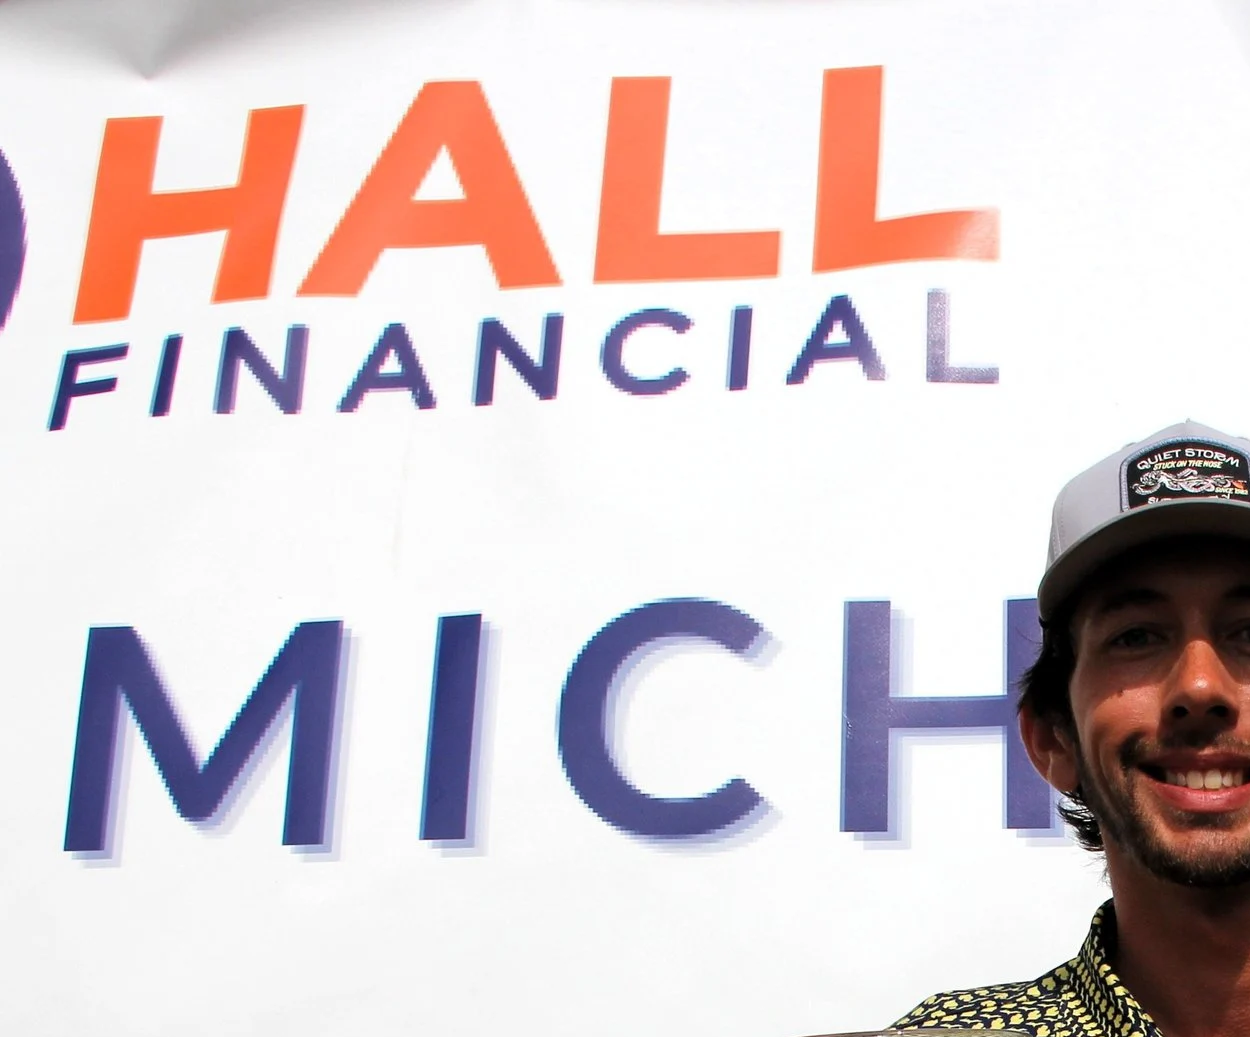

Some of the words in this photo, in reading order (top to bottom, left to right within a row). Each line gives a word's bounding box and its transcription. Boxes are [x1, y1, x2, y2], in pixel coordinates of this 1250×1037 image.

[71, 64, 1000, 326] HALL
[46, 288, 1000, 432] FINANCIAL
[1137, 449, 1181, 470] QUIET
[1185, 448, 1239, 468] STORM
[1153, 461, 1176, 471] STUCK
[1176, 460, 1187, 468] ON
[1188, 460, 1203, 468] THE
[1203, 460, 1223, 469] NOSE
